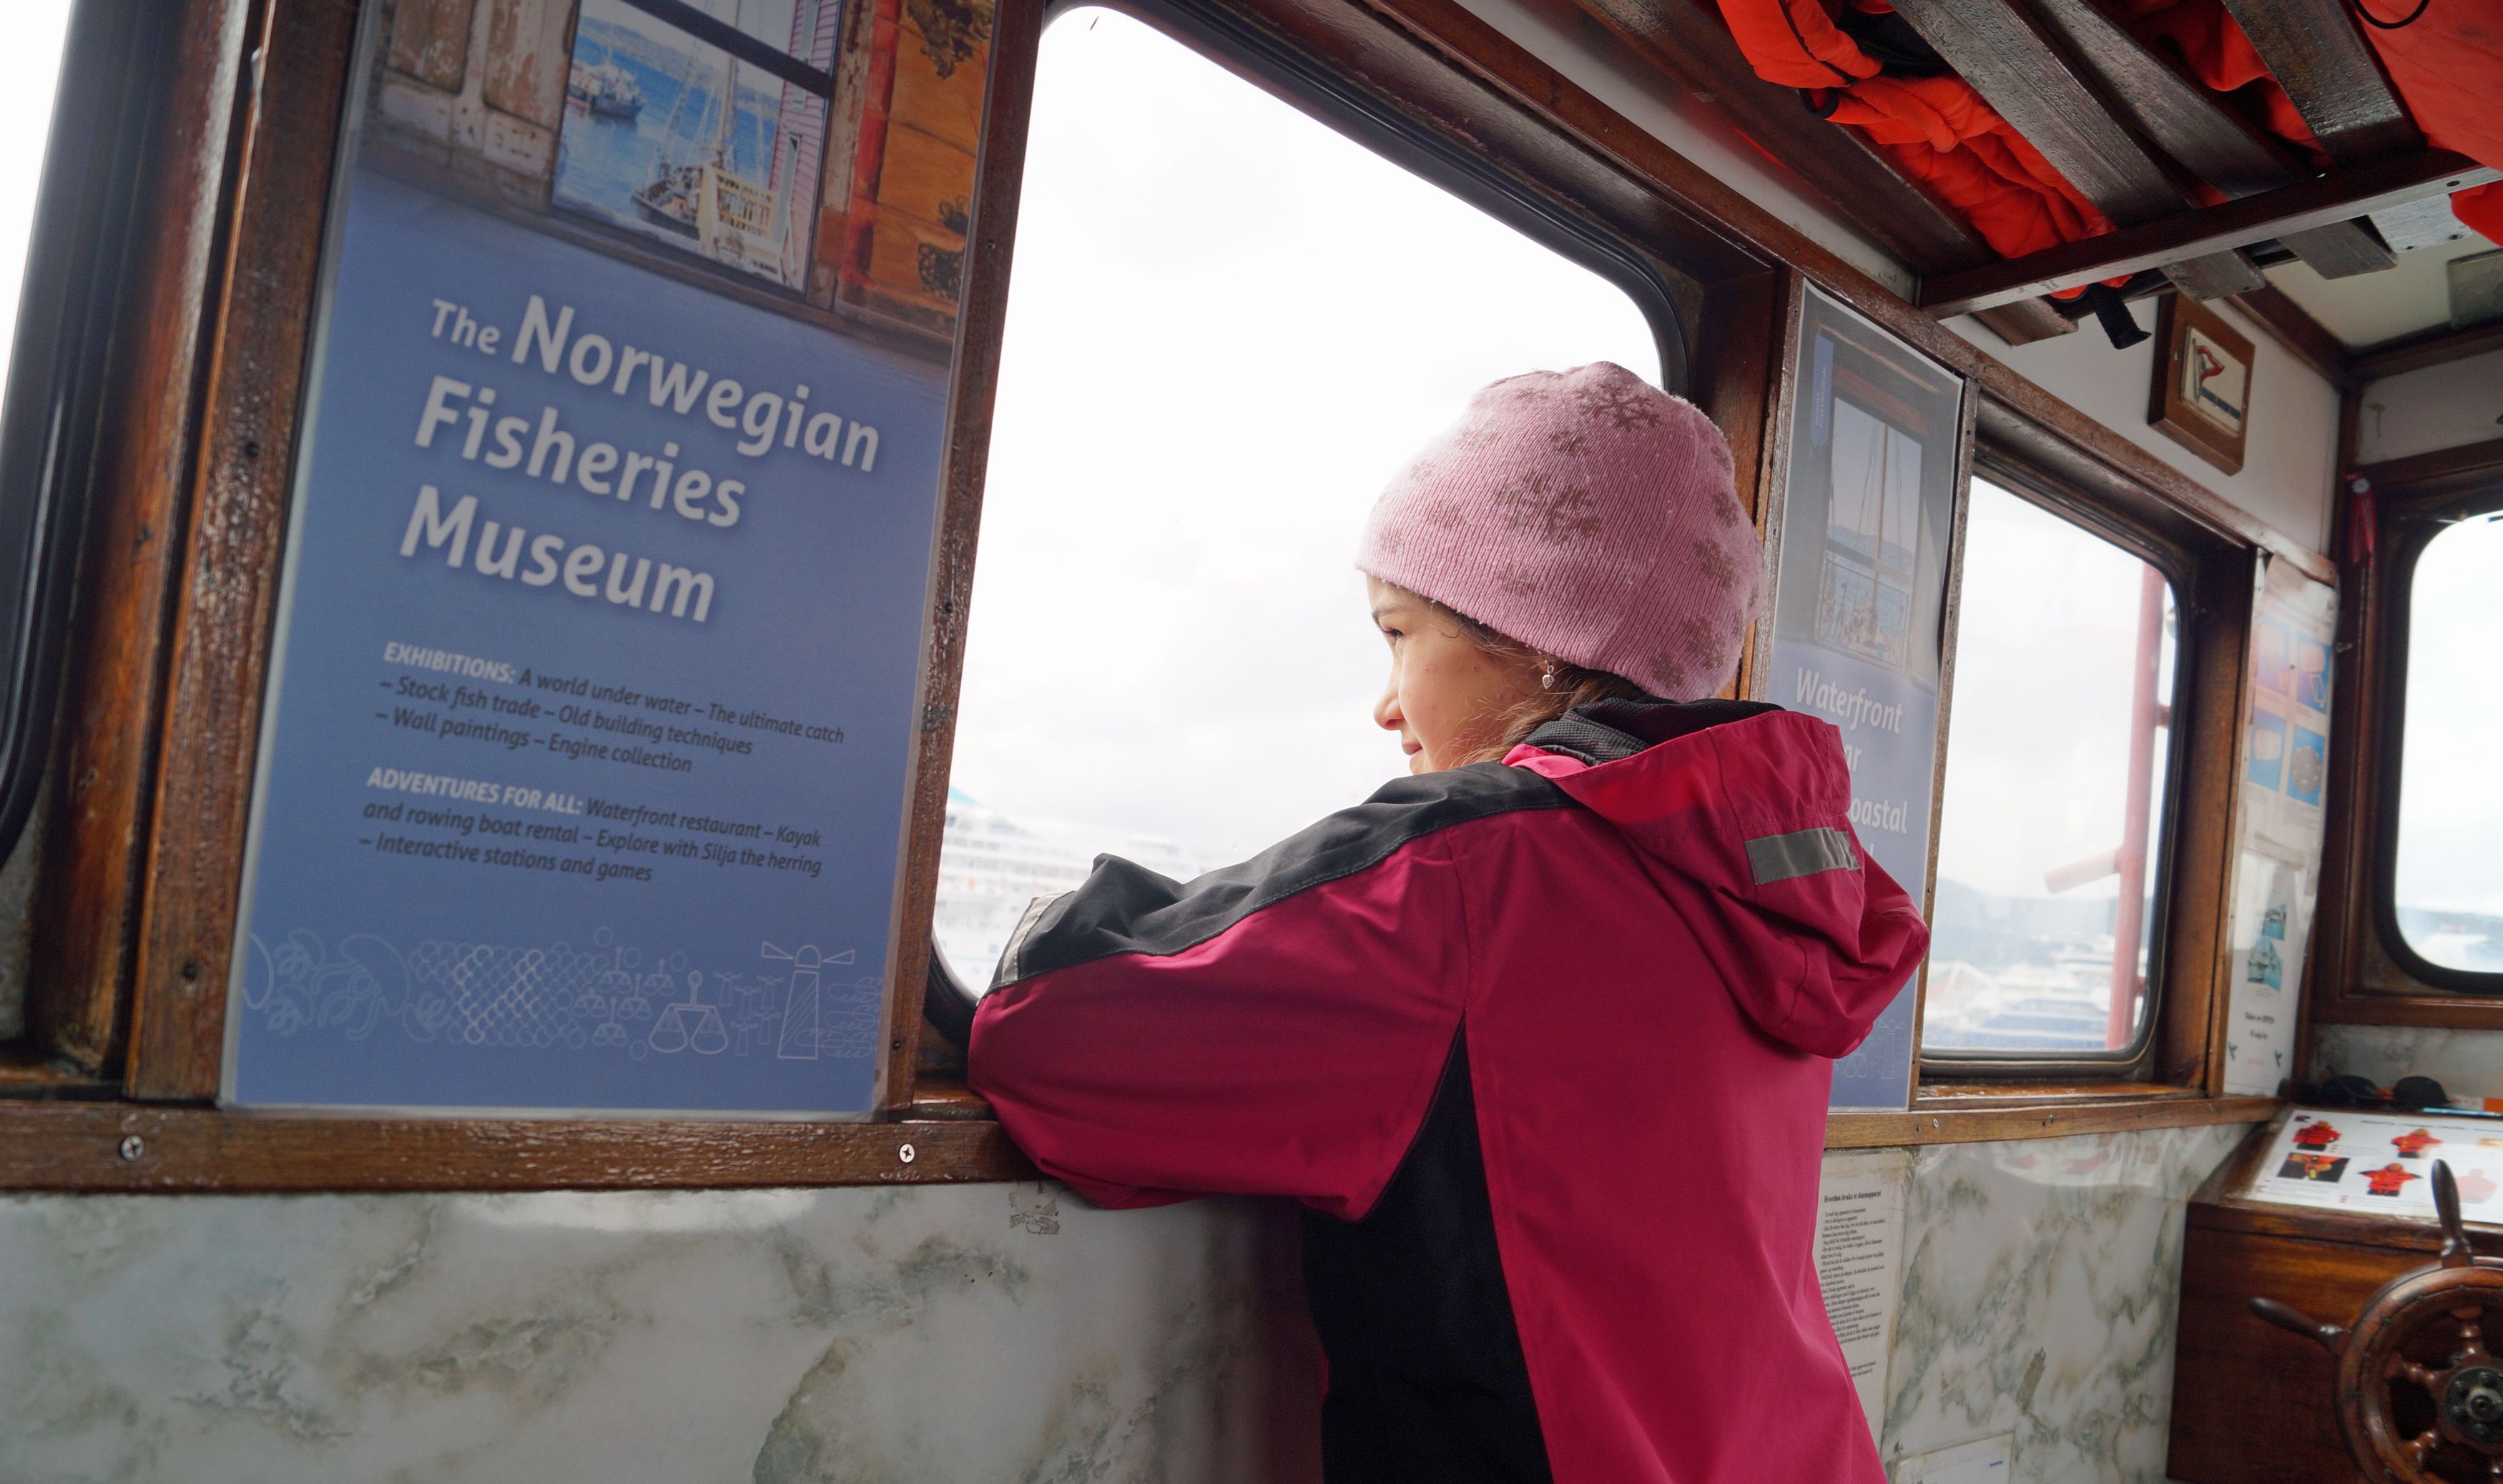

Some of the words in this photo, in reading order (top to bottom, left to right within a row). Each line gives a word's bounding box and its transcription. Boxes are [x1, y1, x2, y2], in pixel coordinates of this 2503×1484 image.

[431, 298, 501, 355] The
[511, 295, 880, 473] Norwegian
[414, 375, 746, 528] Fisheries
[399, 483, 714, 623] Museum
[383, 642, 515, 684] EXHIBITIONS:
[518, 668, 532, 686] A
[537, 674, 588, 697] world
[591, 683, 641, 704] under
[644, 694, 691, 714] water
[708, 703, 737, 725] The
[739, 708, 802, 737] ultimate
[805, 723, 845, 744] catch
[395, 676, 449, 703] Stock
[451, 684, 488, 709] fish
[492, 693, 541, 718] trade
[559, 704, 591, 726] Old
[594, 711, 664, 744] building
[667, 724, 753, 757] techniques
[1796, 667, 1904, 734] Waterfront
[393, 707, 436, 732] Wall
[439, 715, 529, 750] paintings
[548, 733, 608, 761] Engine
[611, 744, 692, 773] collection
[363, 800, 402, 822] and
[405, 810, 475, 835] rowing
[478, 810, 522, 837] boat
[525, 820, 579, 845] rental
[596, 829, 659, 857] Explore
[662, 838, 698, 860] with
[701, 842, 737, 866] Silja
[739, 847, 764, 868] the
[767, 851, 822, 878] herring
[367, 767, 500, 805] ADVENTURES
[502, 786, 540, 809] FOR
[543, 792, 584, 815] ALL:
[585, 798, 677, 828] Waterfront
[679, 814, 762, 841] restaurant
[775, 825, 822, 848] Kayak
[1850, 797, 1908, 834] oastal
[375, 832, 481, 864] Interactive
[483, 845, 556, 871] stations
[560, 855, 595, 875] and
[597, 862, 653, 883] games
